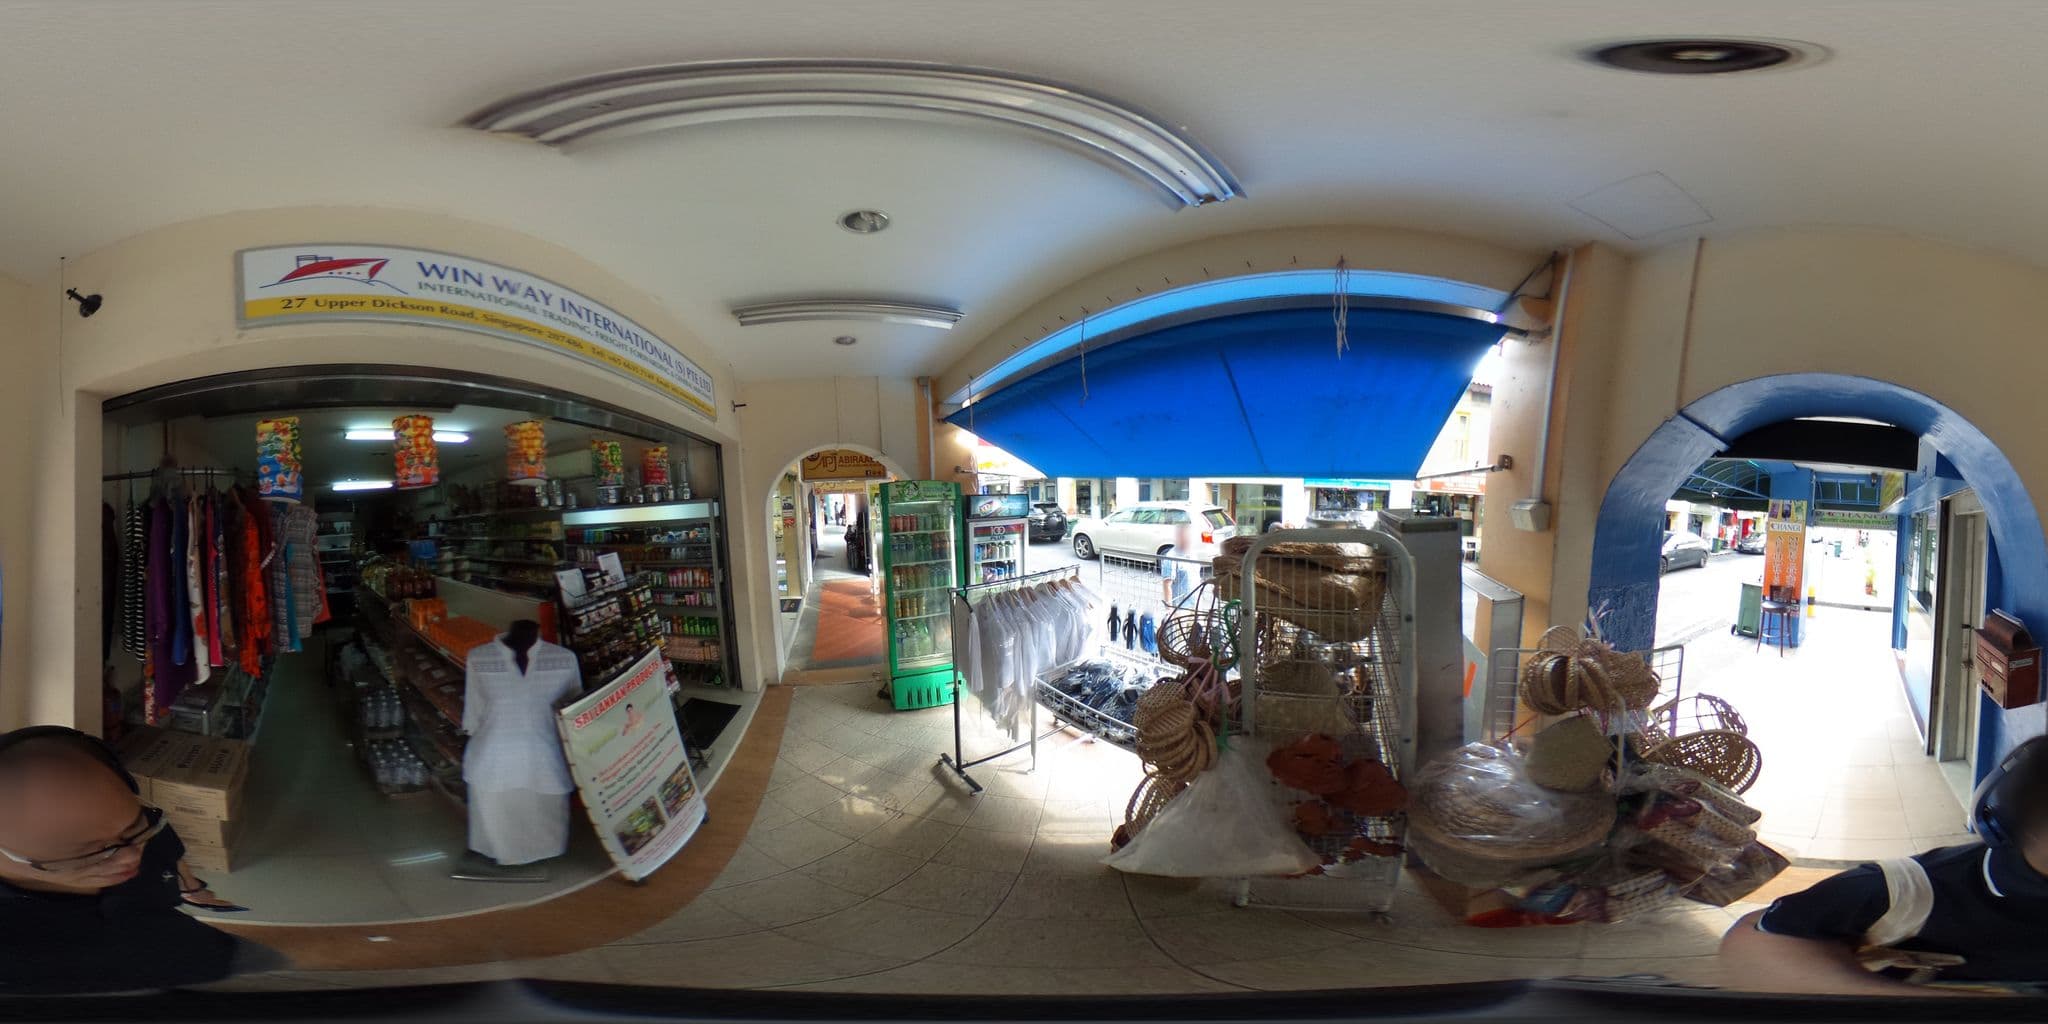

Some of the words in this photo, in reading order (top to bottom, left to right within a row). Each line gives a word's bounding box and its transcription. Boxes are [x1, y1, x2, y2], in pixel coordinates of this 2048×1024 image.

[280, 298, 307, 309] 27
[315, 299, 366, 309] Upper
[372, 299, 435, 312] Dickson
[416, 261, 484, 288] WIN
[491, 275, 552, 306] WAY
[560, 297, 674, 369] INTERNATIONAL
[674, 359, 686, 376] (S)
[686, 367, 698, 386] PTE
[699, 376, 711, 393] LTD
[418, 281, 537, 315] INTERNATIONAL
[542, 309, 593, 336] TRADING,
[574, 712, 593, 728] SRI
[594, 686, 627, 717] LANKAN
[626, 660, 660, 692] PRODUCTS
